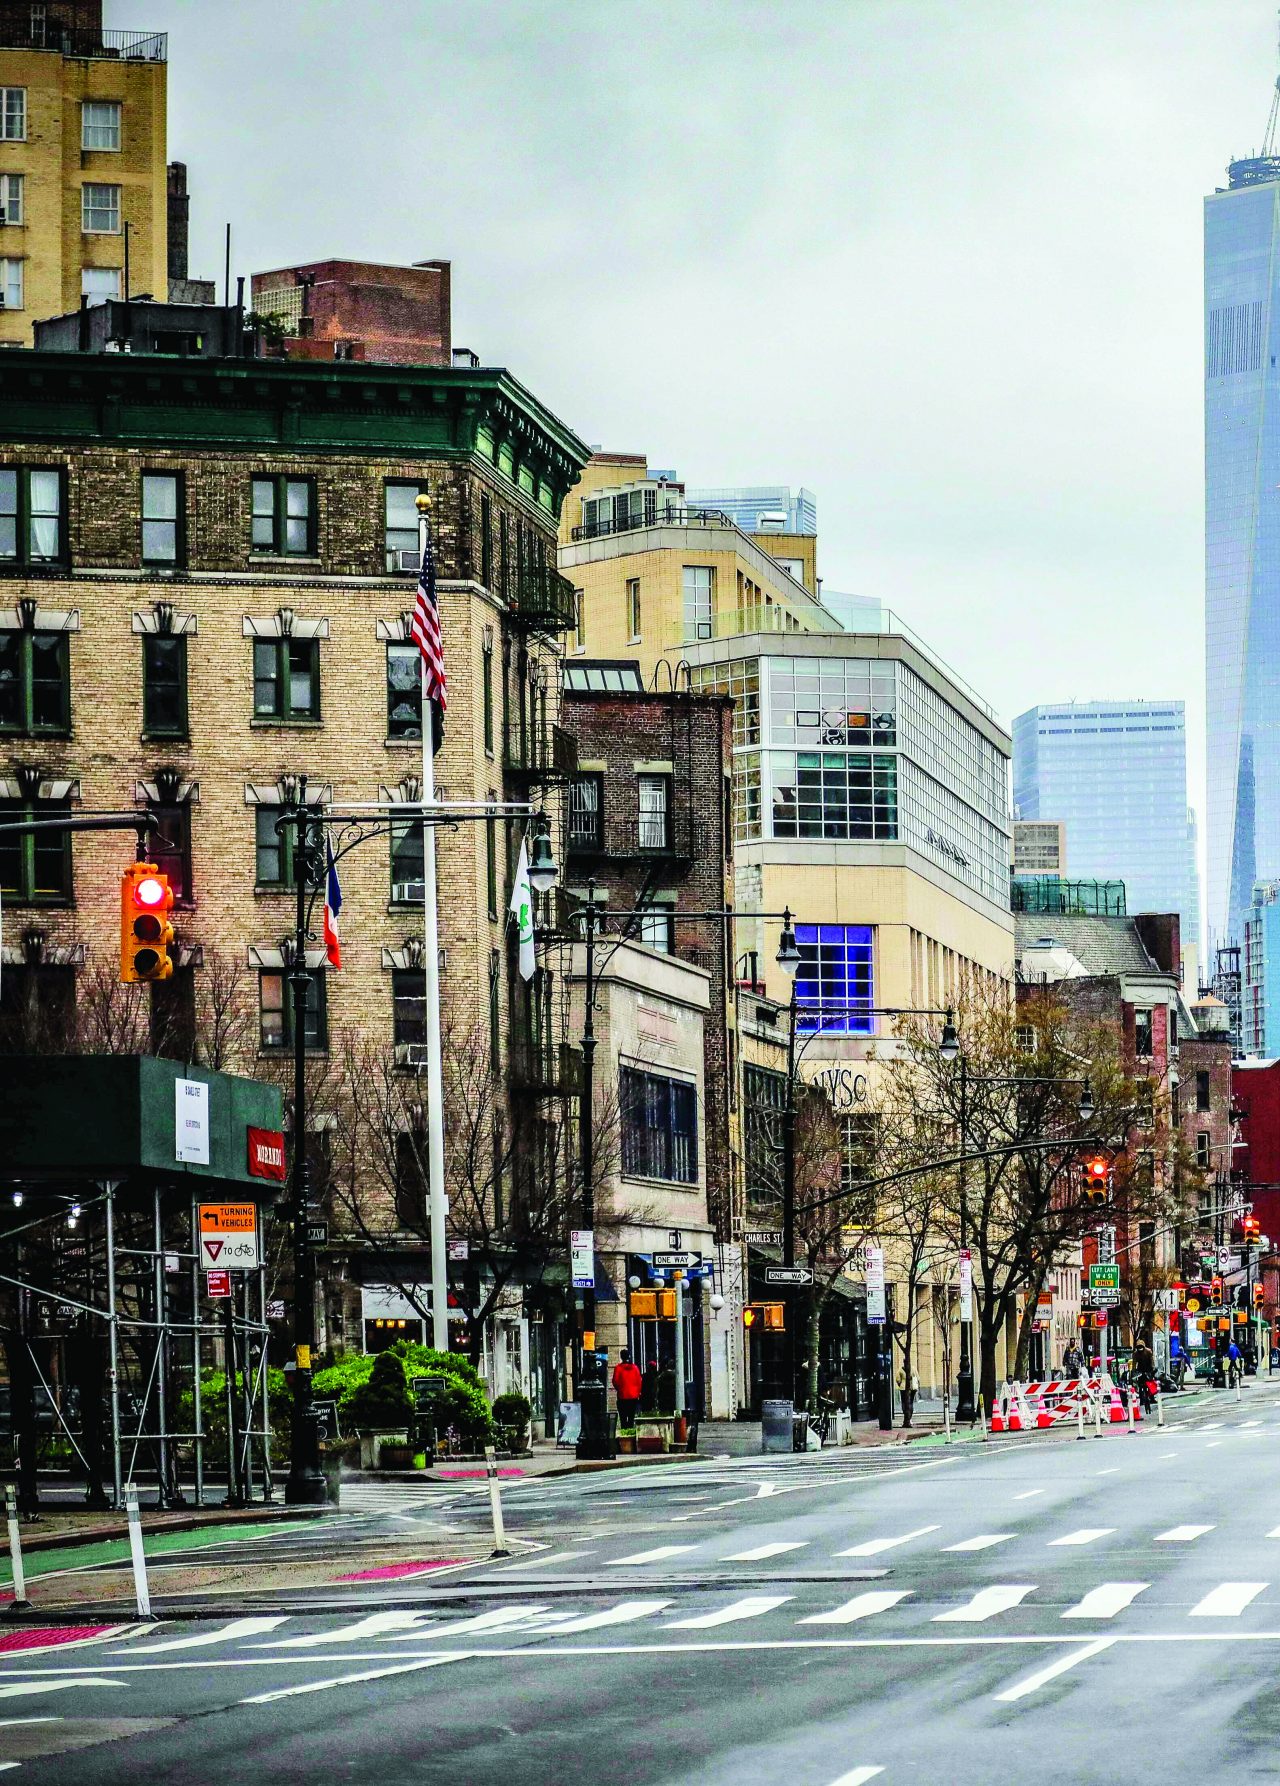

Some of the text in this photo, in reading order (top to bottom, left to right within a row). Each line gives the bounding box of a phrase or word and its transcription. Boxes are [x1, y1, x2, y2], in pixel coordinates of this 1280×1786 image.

[256, 1144, 282, 1167] MORANDI
[220, 1208, 253, 1216] TURNING
[221, 1219, 253, 1227] VEHICLES
[744, 1233, 781, 1244] CHARLES ST
[223, 1247, 232, 1255] TO
[657, 1256, 689, 1264] ONE WAY
[1091, 1288, 1121, 1297] COFEE
